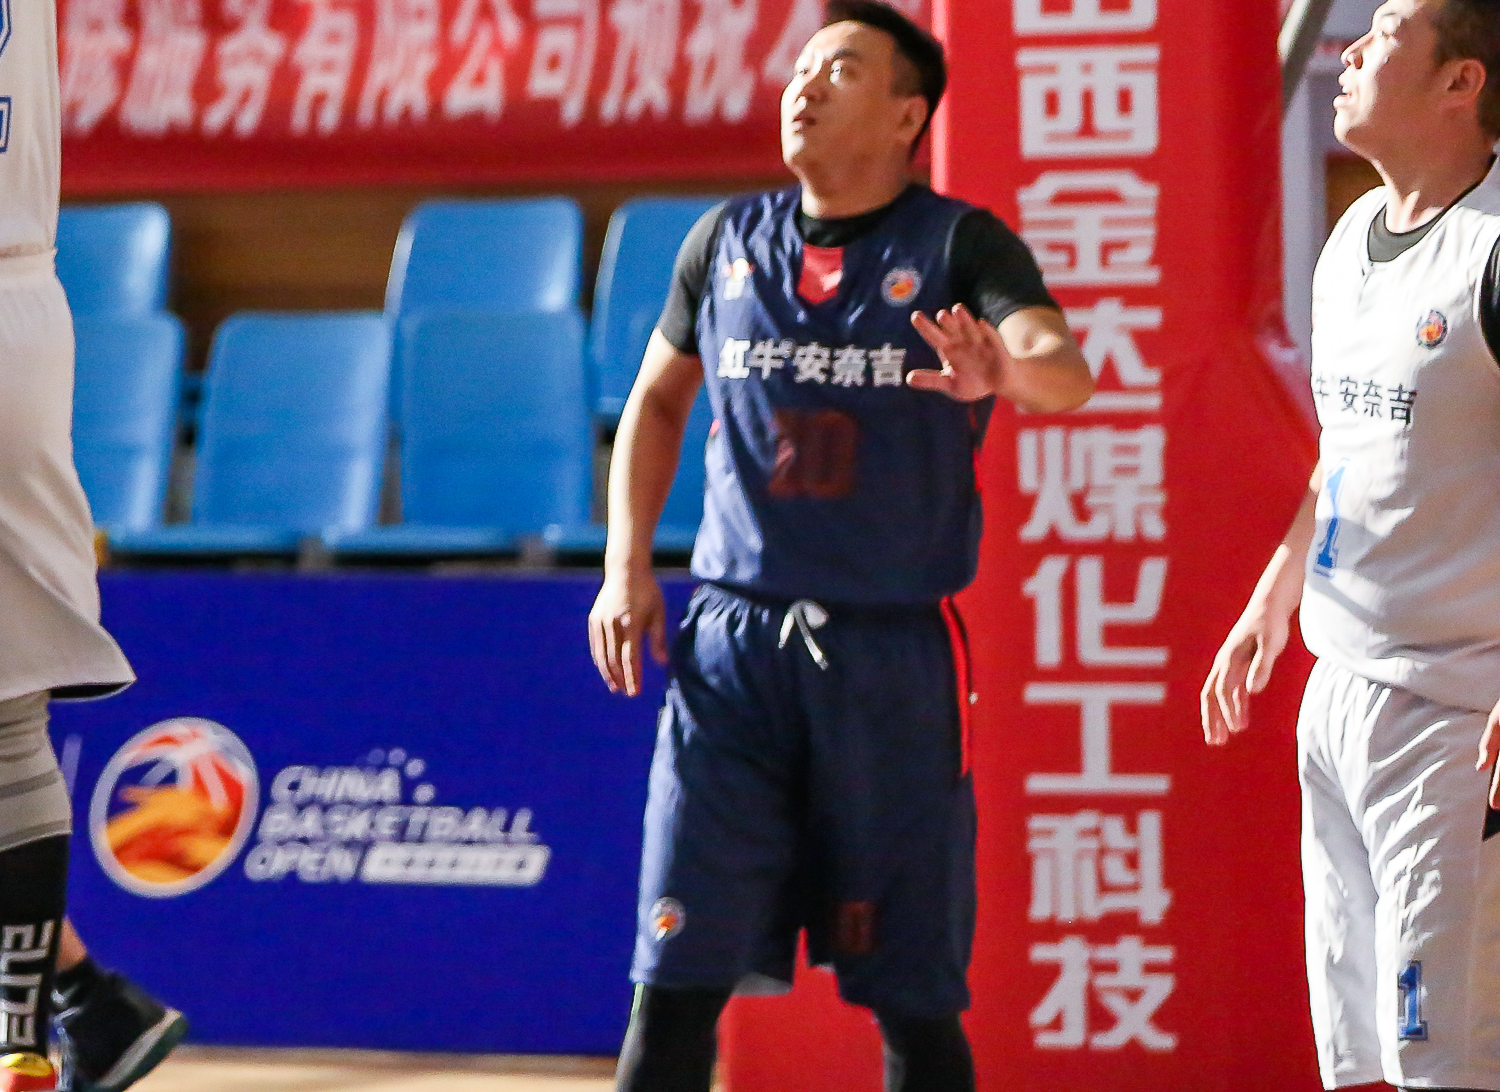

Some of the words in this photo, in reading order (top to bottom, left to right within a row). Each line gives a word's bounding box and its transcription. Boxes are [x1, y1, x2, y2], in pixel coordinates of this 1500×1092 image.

[271, 765, 401, 804] CHINA
[257, 804, 542, 843] BASKETBALL
[243, 841, 363, 883] OPEN
